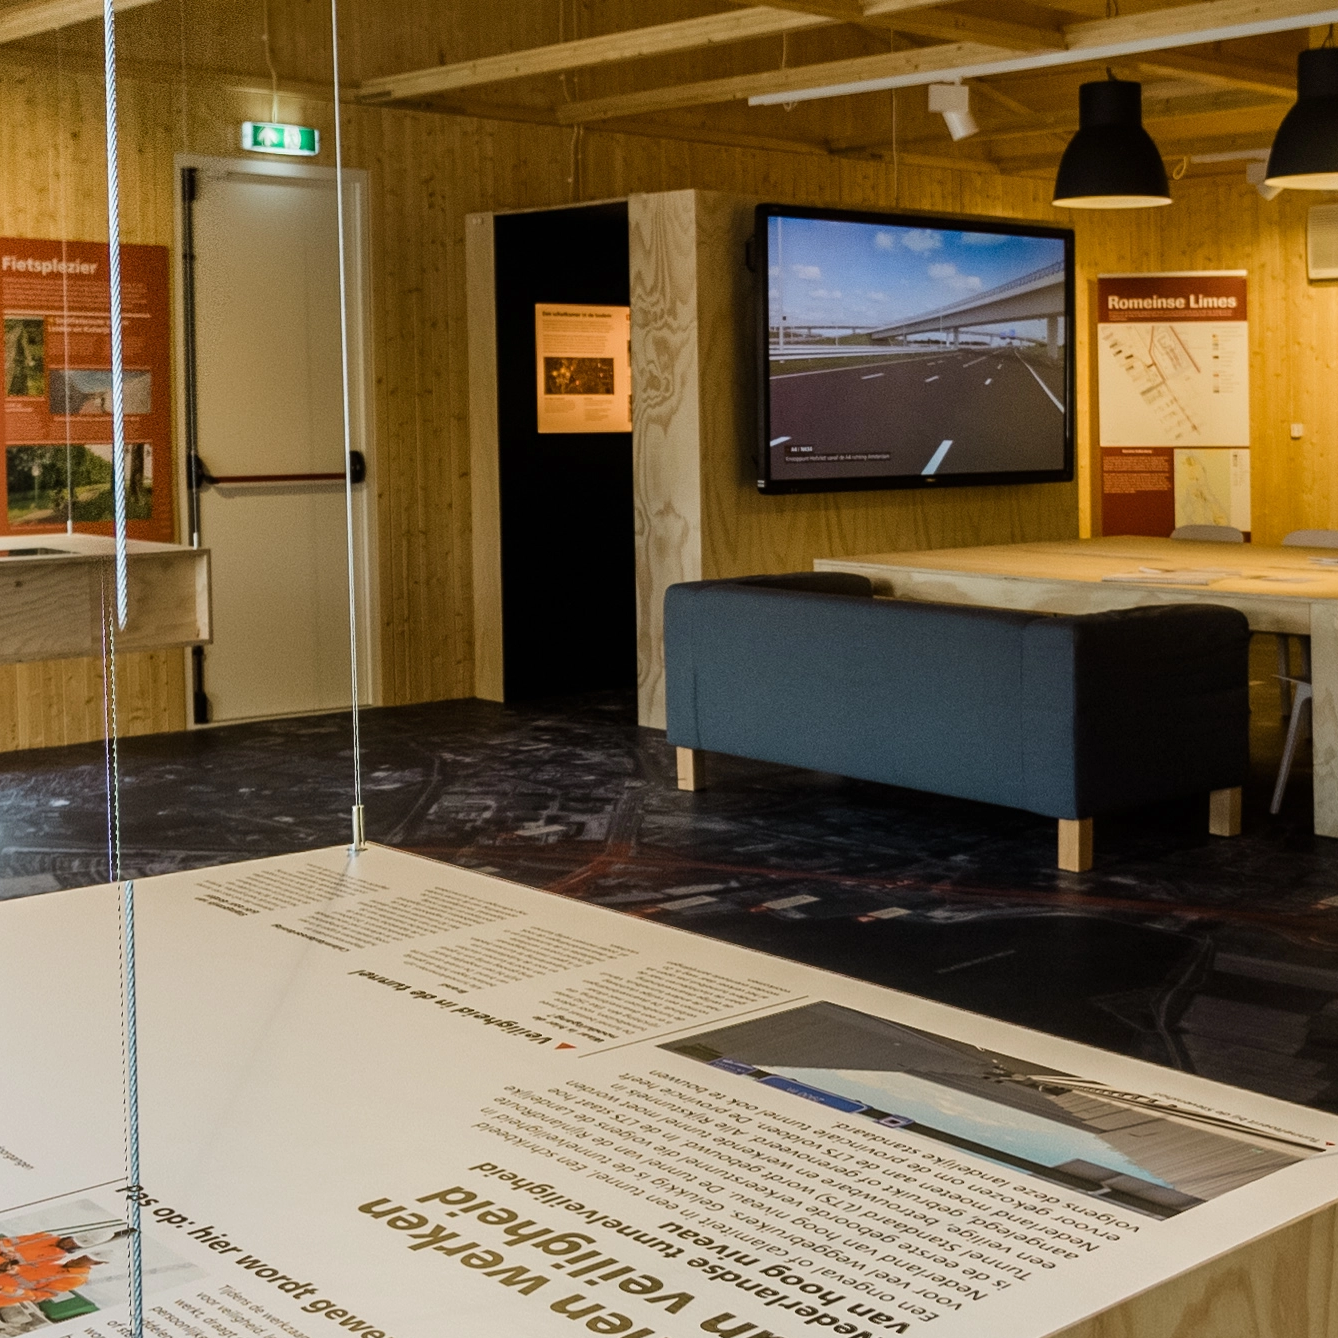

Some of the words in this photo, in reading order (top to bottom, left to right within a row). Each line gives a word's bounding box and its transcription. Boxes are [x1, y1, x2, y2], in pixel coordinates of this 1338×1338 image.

[2, 256, 98, 275] Fietsplezier
[1108, 295, 1185, 309] Romeinse
[1189, 294, 1237, 308] Limes
[347, 970, 412, 991] tunnel
[409, 990, 437, 1000] de
[434, 999, 459, 1009] in
[449, 1007, 553, 1045] Veiligheid
[566, 1080, 621, 1103] worden
[610, 1083, 628, 1092] in
[618, 1073, 661, 1090] heeft
[649, 1070, 709, 1094] bouwen
[504, 1086, 575, 1116] Landelijke
[547, 1088, 578, 1102] hoe
[574, 1099, 615, 1115] staat
[625, 1089, 715, 1124] Rijkstunnels
[659, 1087, 733, 1114] provincie
[708, 1092, 727, 1100] te
[726, 1098, 758, 1111] ook
[480, 1107, 498, 1116] in
[494, 1097, 593, 1139] RijnlandRoute
[573, 1113, 596, 1123] de
[609, 1114, 641, 1126] LTS
[618, 1101, 662, 1118] moet
[728, 1112, 754, 1124] De
[754, 1110, 812, 1131] tunnel
[491, 1114, 613, 1164] tunnelveiligheid
[593, 1122, 653, 1147] volgens
[639, 1124, 662, 1134] de
[656, 1117, 712, 1138] tunnel
[662, 1132, 681, 1142] In
[714, 1122, 750, 1136] Alle
[757, 1122, 823, 1150] voldoen.
[831, 1121, 922, 1154] standaard.
[471, 1122, 559, 1158] schrikbeeld
[591, 1136, 614, 1147] de
[653, 1145, 681, 1157] die
[813, 1129, 910, 1164] provinciale
[556, 1156, 589, 1172] Een
[613, 1146, 643, 1160] van
[679, 1139, 766, 1173] gebouwd.
[712, 1136, 794, 1170] werkende
[747, 1135, 863, 1177] gerenoveerd.
[820, 1148, 855, 1162] LTS
[855, 1159, 881, 1170] de
[612, 1162, 636, 1173] de
[633, 1172, 652, 1181] is
[639, 1158, 699, 1182] tunnel
[795, 1168, 820, 1179] en
[881, 1169, 919, 1184] aan
[907, 1163, 932, 1173] de
[921, 1153, 1011, 1188] landelijke
[933, 1172, 965, 1185] om
[586, 1169, 646, 1196] tunnel.
[675, 1156, 804, 1207] verkeerstunnel
[698, 1180, 729, 1194] De
[760, 1171, 816, 1195] wordt
[852, 1177, 886, 1186] of
[645, 1194, 679, 1210] een
[649, 1177, 725, 1212] Gelukkig
[728, 1191, 791, 1219] niveau.
[814, 1193, 863, 1213] (LTS)
[818, 1178, 950, 1228] betrouwbare
[881, 1185, 968, 1221] gebruikt
[918, 1182, 993, 1212] moeten
[967, 1184, 1054, 1216] gekozen
[1012, 1185, 1067, 1206] deze
[468, 1162, 685, 1258] tunnelveiligheid
[679, 1209, 701, 1221] in
[1061, 1198, 1140, 1233] volgens
[789, 1217, 843, 1242] hoog
[805, 1205, 901, 1243] geboorde
[857, 1211, 964, 1252] Standaard
[986, 1208, 1101, 1252] Nederland
[1050, 1216, 1120, 1241] ervoor
[358, 1198, 551, 1296] werken
[657, 1221, 762, 1267] niveau
[696, 1217, 795, 1257] calamiteit
[729, 1210, 867, 1271] weggebruikers.
[831, 1233, 878, 1256] van
[929, 1219, 1013, 1254] veilige,
[953, 1213, 1079, 1260] aangelegd,
[153, 1208, 197, 1229] op:
[187, 1225, 243, 1254] hier
[235, 1255, 319, 1300] wordt
[415, 1186, 695, 1315] veiligheid
[781, 1256, 814, 1267] of
[897, 1242, 960, 1268] eerste
[1016, 1252, 1056, 1269] een
[957, 1248, 1032, 1281] Tunnel
[961, 1267, 993, 1281] de
[758, 1264, 847, 1307] hoog
[809, 1266, 896, 1302] ongeval
[863, 1269, 912, 1289] veel
[875, 1254, 988, 1301] Nederland
[991, 1280, 1012, 1291] is
[218, 1284, 253, 1306] Tijdens
[248, 1305, 266, 1314] de
[911, 1288, 963, 1311] voor
[196, 1292, 221, 1306] voor
[217, 1305, 269, 1336] veiligheid.
[847, 1303, 911, 1334] van
[897, 1301, 940, 1322] Een
